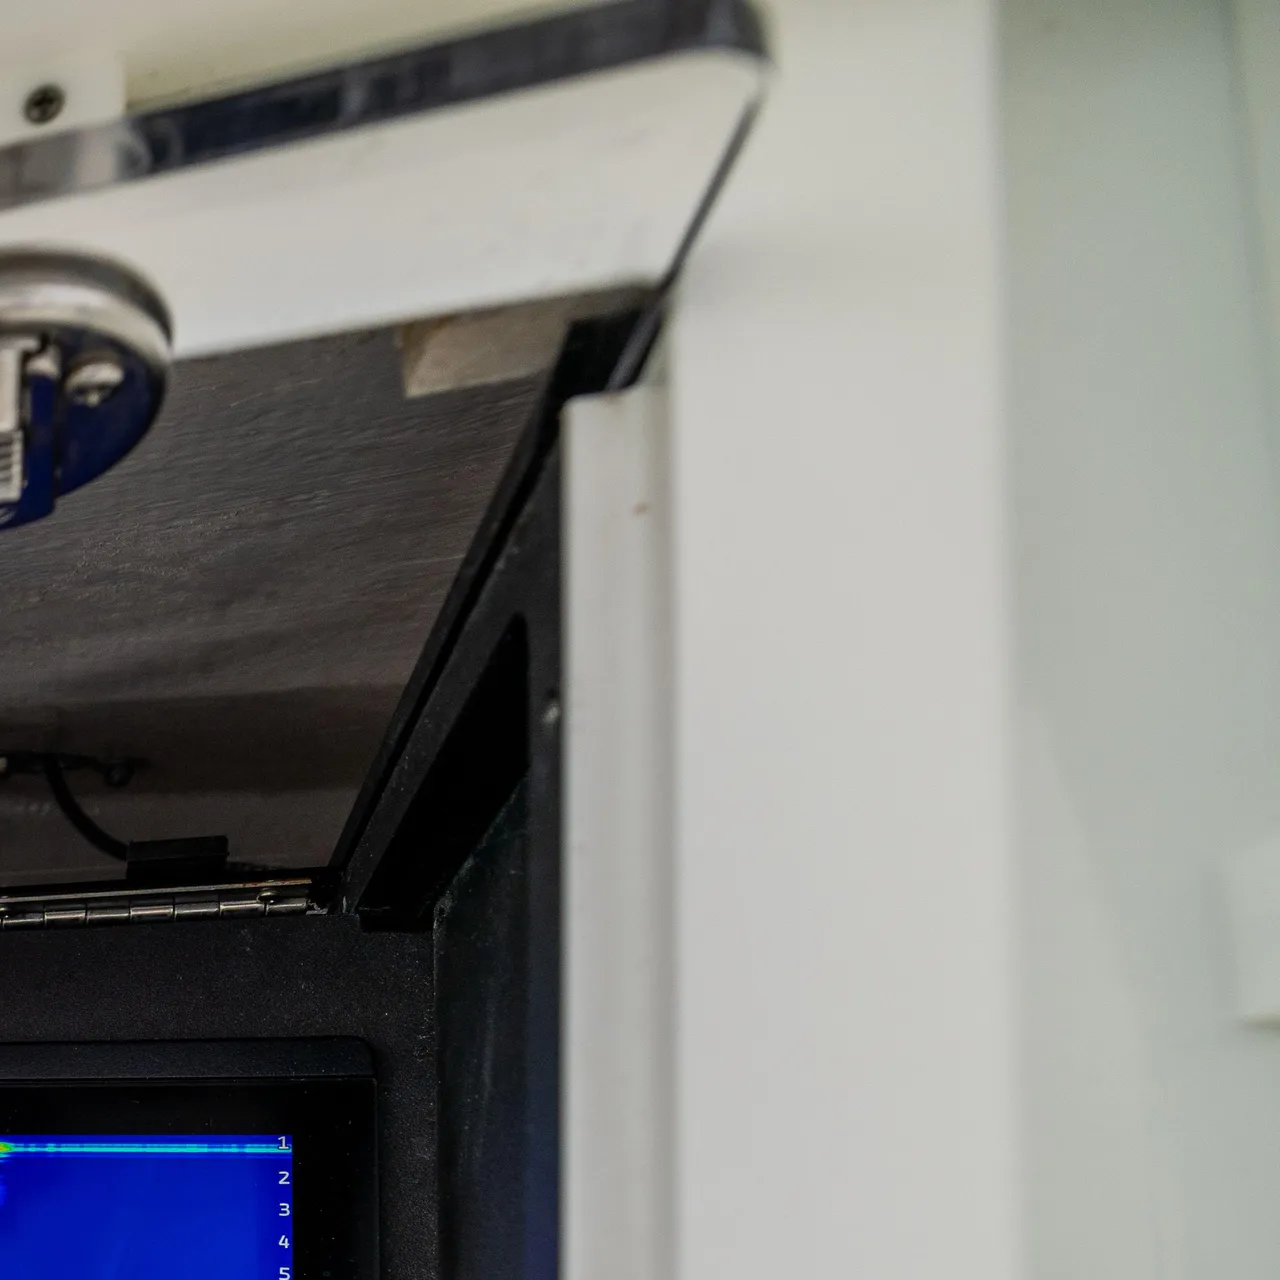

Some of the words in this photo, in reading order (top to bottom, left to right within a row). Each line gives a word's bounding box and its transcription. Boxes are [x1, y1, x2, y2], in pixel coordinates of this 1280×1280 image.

[278, 1136, 289, 1149] 1
[278, 1171, 290, 1185] 2
[278, 1203, 290, 1217] 3
[278, 1235, 290, 1249] 4
[278, 1267, 291, 1280] 5
